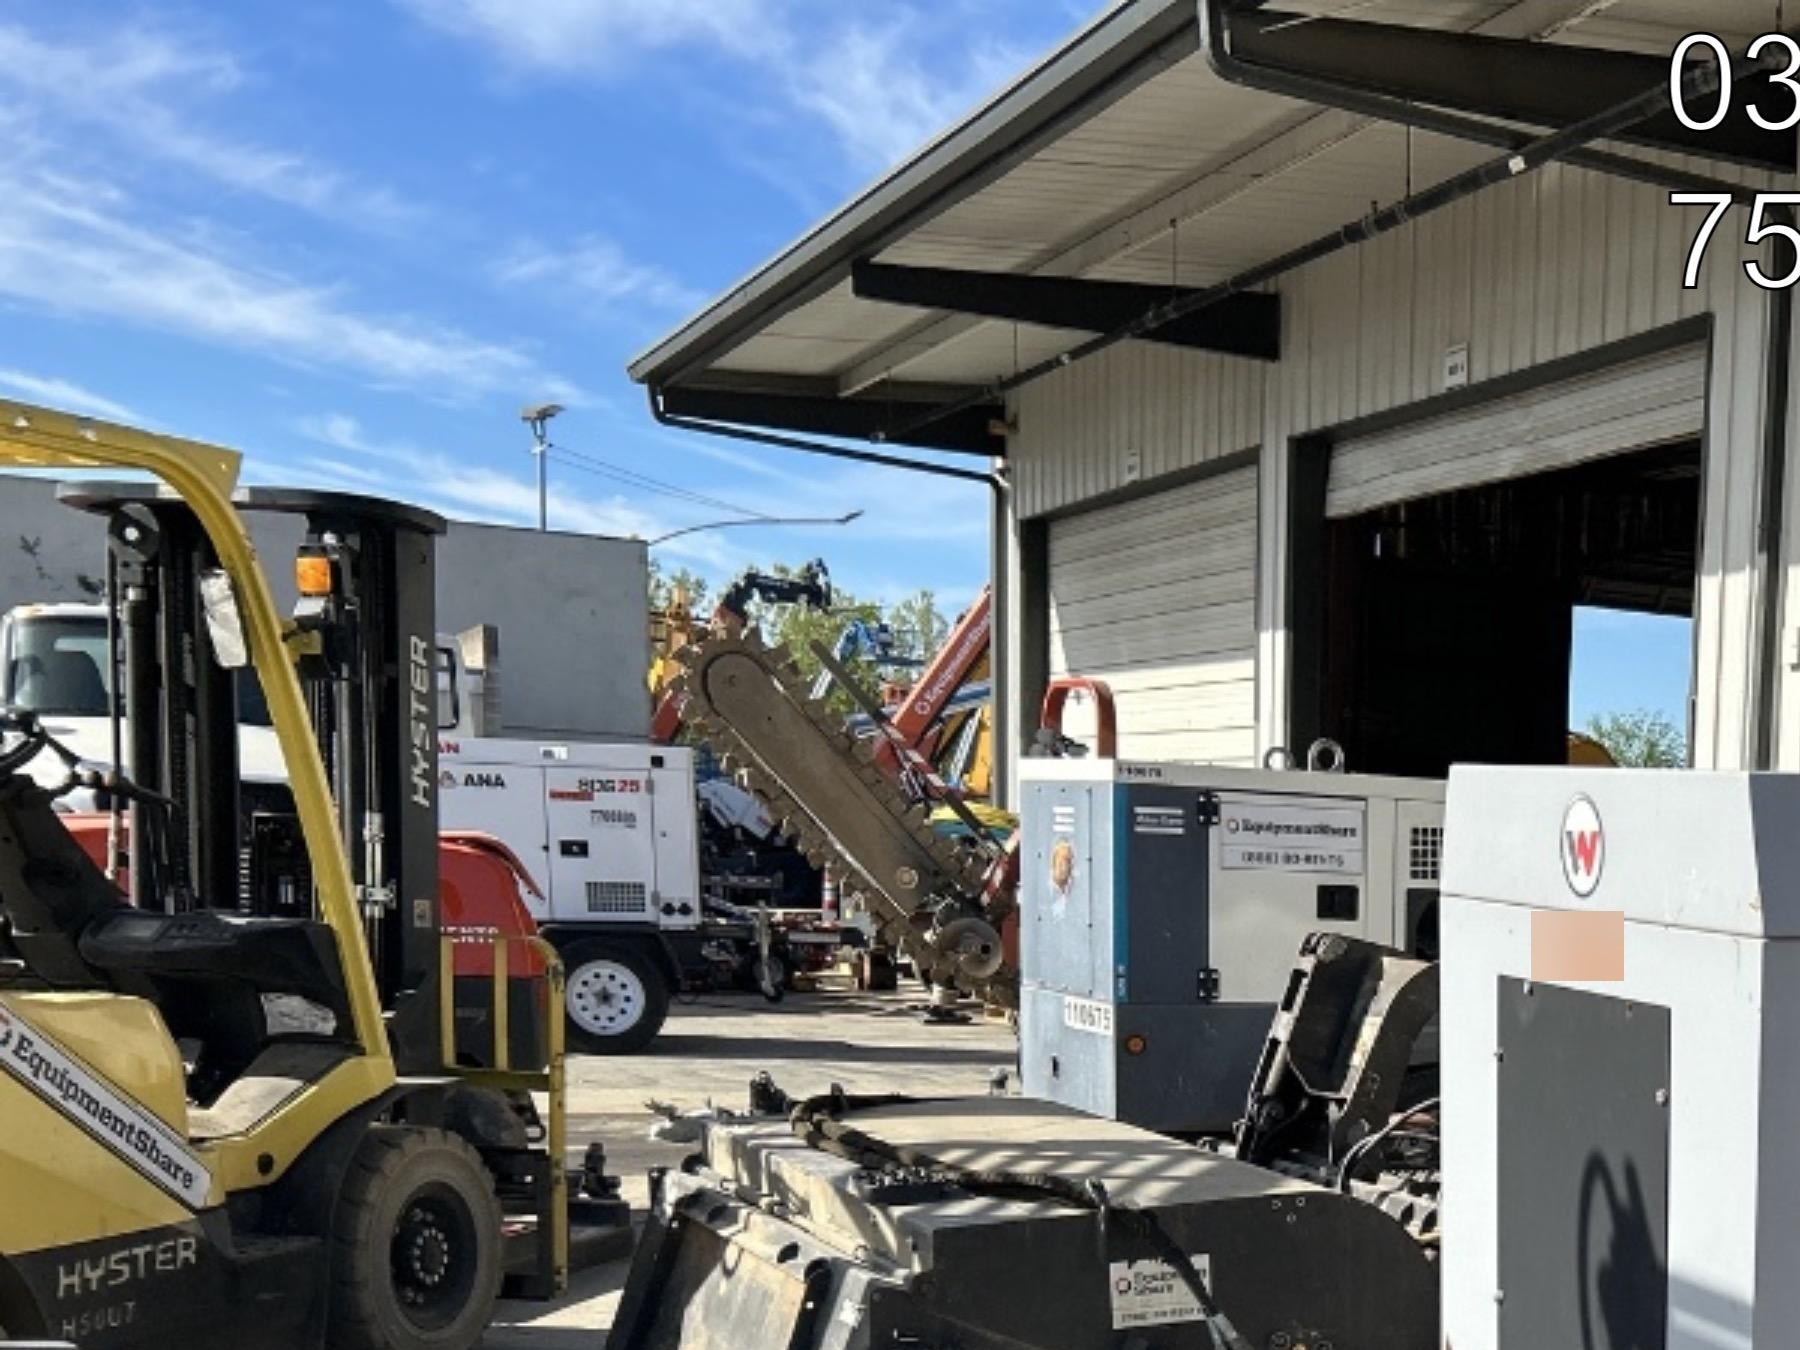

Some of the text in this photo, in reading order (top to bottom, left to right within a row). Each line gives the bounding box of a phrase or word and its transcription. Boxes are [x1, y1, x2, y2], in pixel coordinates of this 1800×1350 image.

[410, 634, 430, 808] HYSTER
[11, 1030, 197, 1191] EquipmentShare
[56, 1236, 198, 1300] HYSTER
